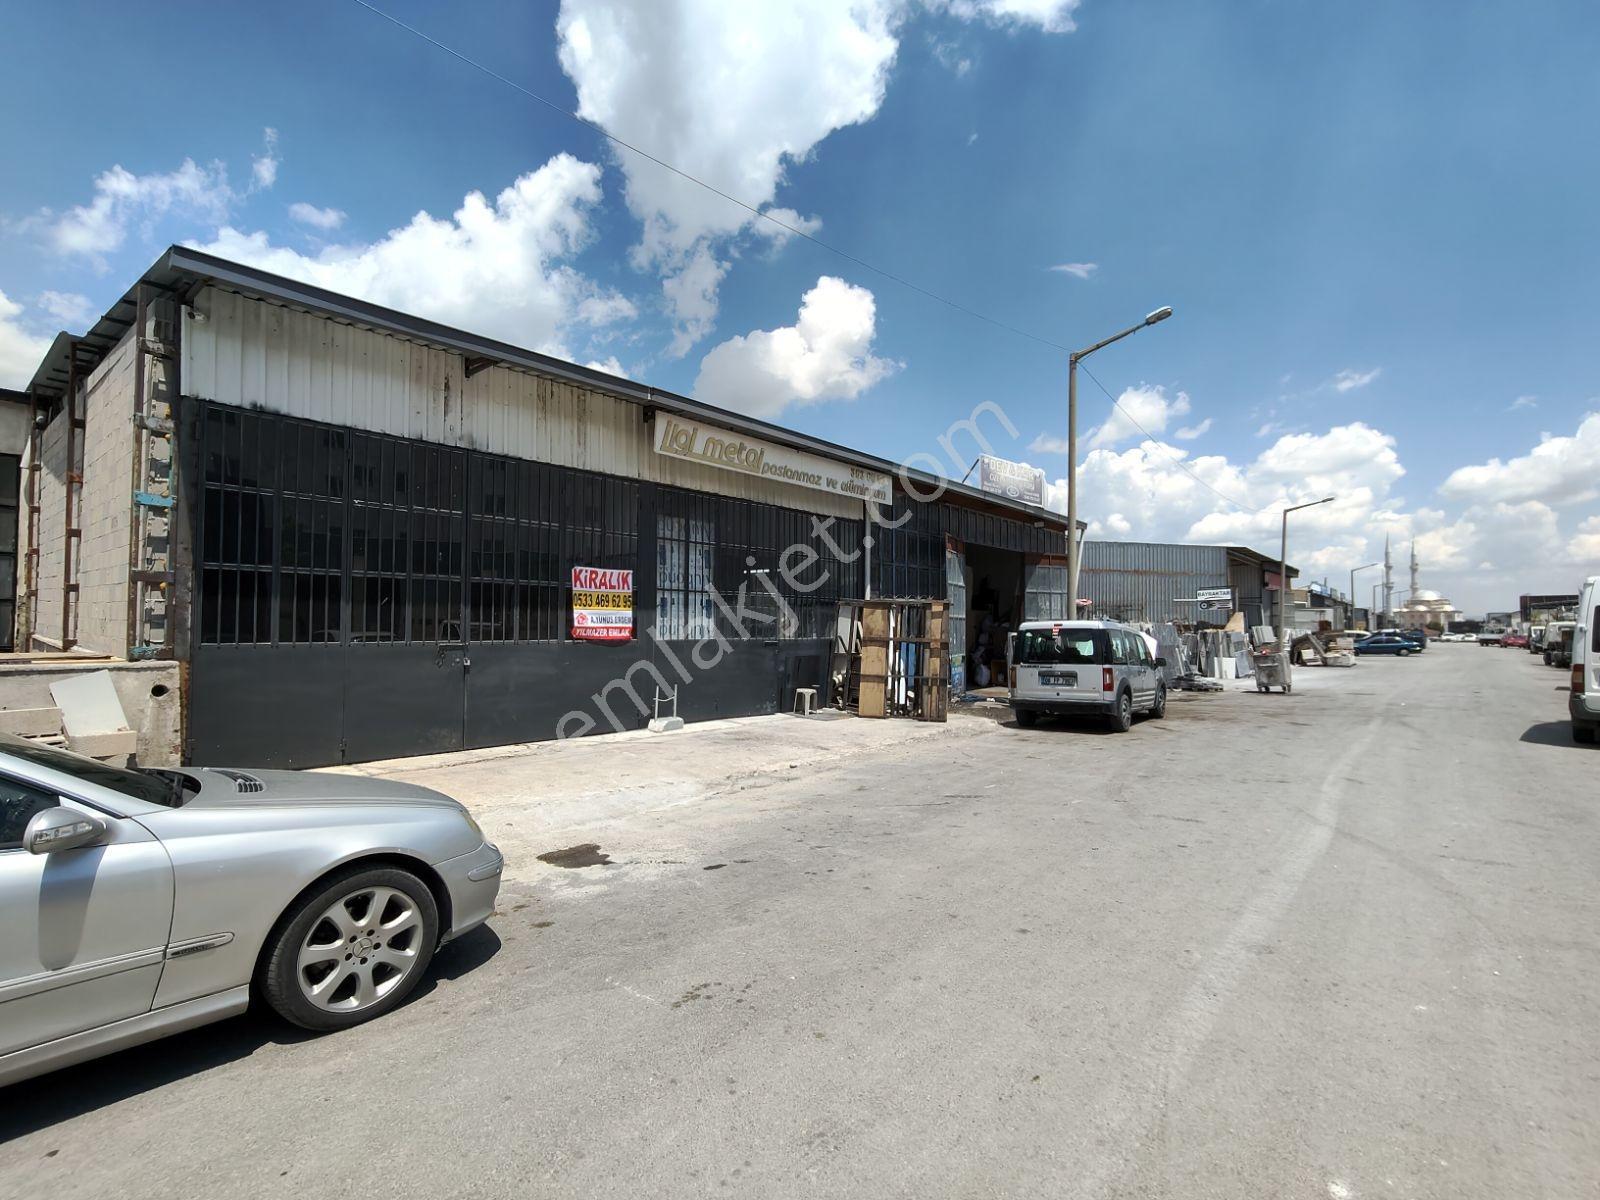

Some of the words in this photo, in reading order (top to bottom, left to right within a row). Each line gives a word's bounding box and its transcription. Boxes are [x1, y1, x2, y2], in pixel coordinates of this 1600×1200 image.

[703, 437, 764, 472] metal
[761, 462, 822, 486] paslanmaz
[826, 477, 839, 490] ve
[573, 592, 593, 608] 0533
[595, 593, 610, 608] 469
[611, 594, 621, 609] 62
[622, 594, 632, 609] 95
